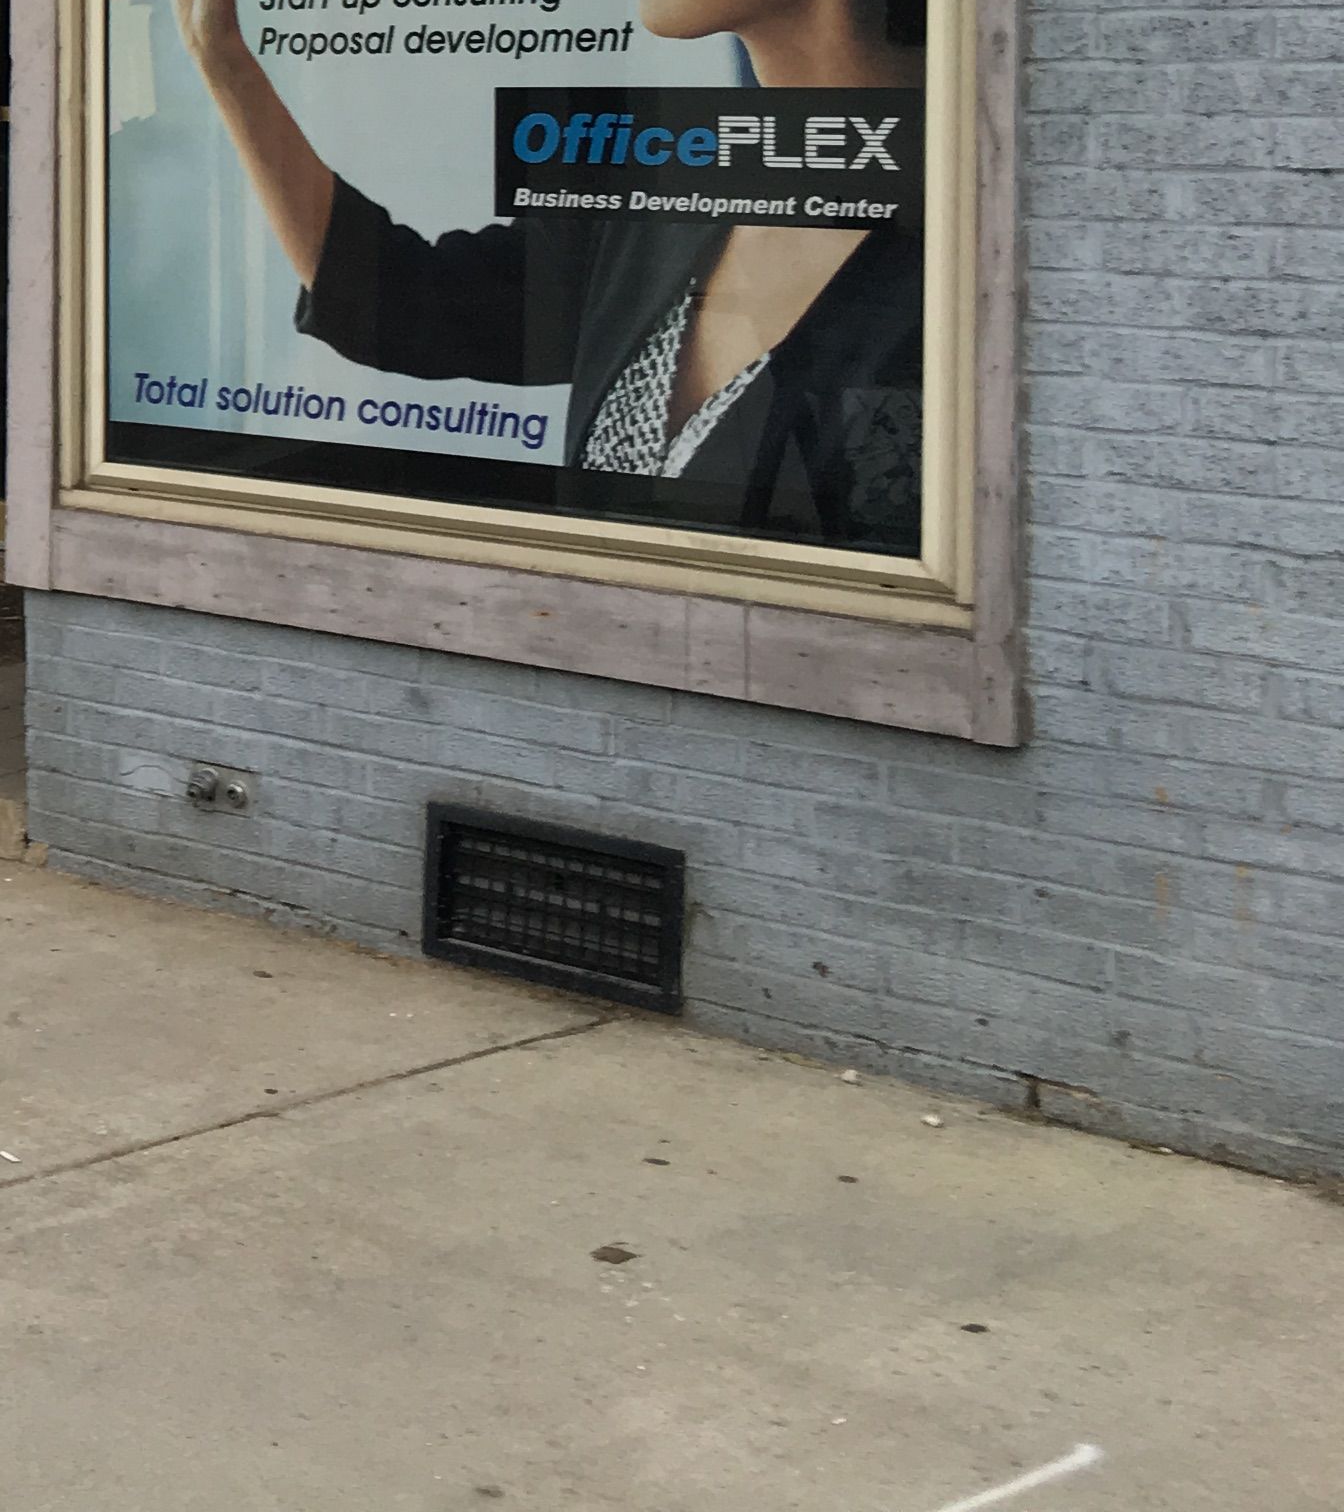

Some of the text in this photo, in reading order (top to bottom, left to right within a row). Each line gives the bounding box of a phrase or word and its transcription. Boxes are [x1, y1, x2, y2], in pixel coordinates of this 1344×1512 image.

[258, 21, 634, 61] Proposal development
[512, 112, 901, 172] OfficePLEX
[513, 188, 899, 219] Business Development Center
[134, 372, 548, 450] Total solution consulting
